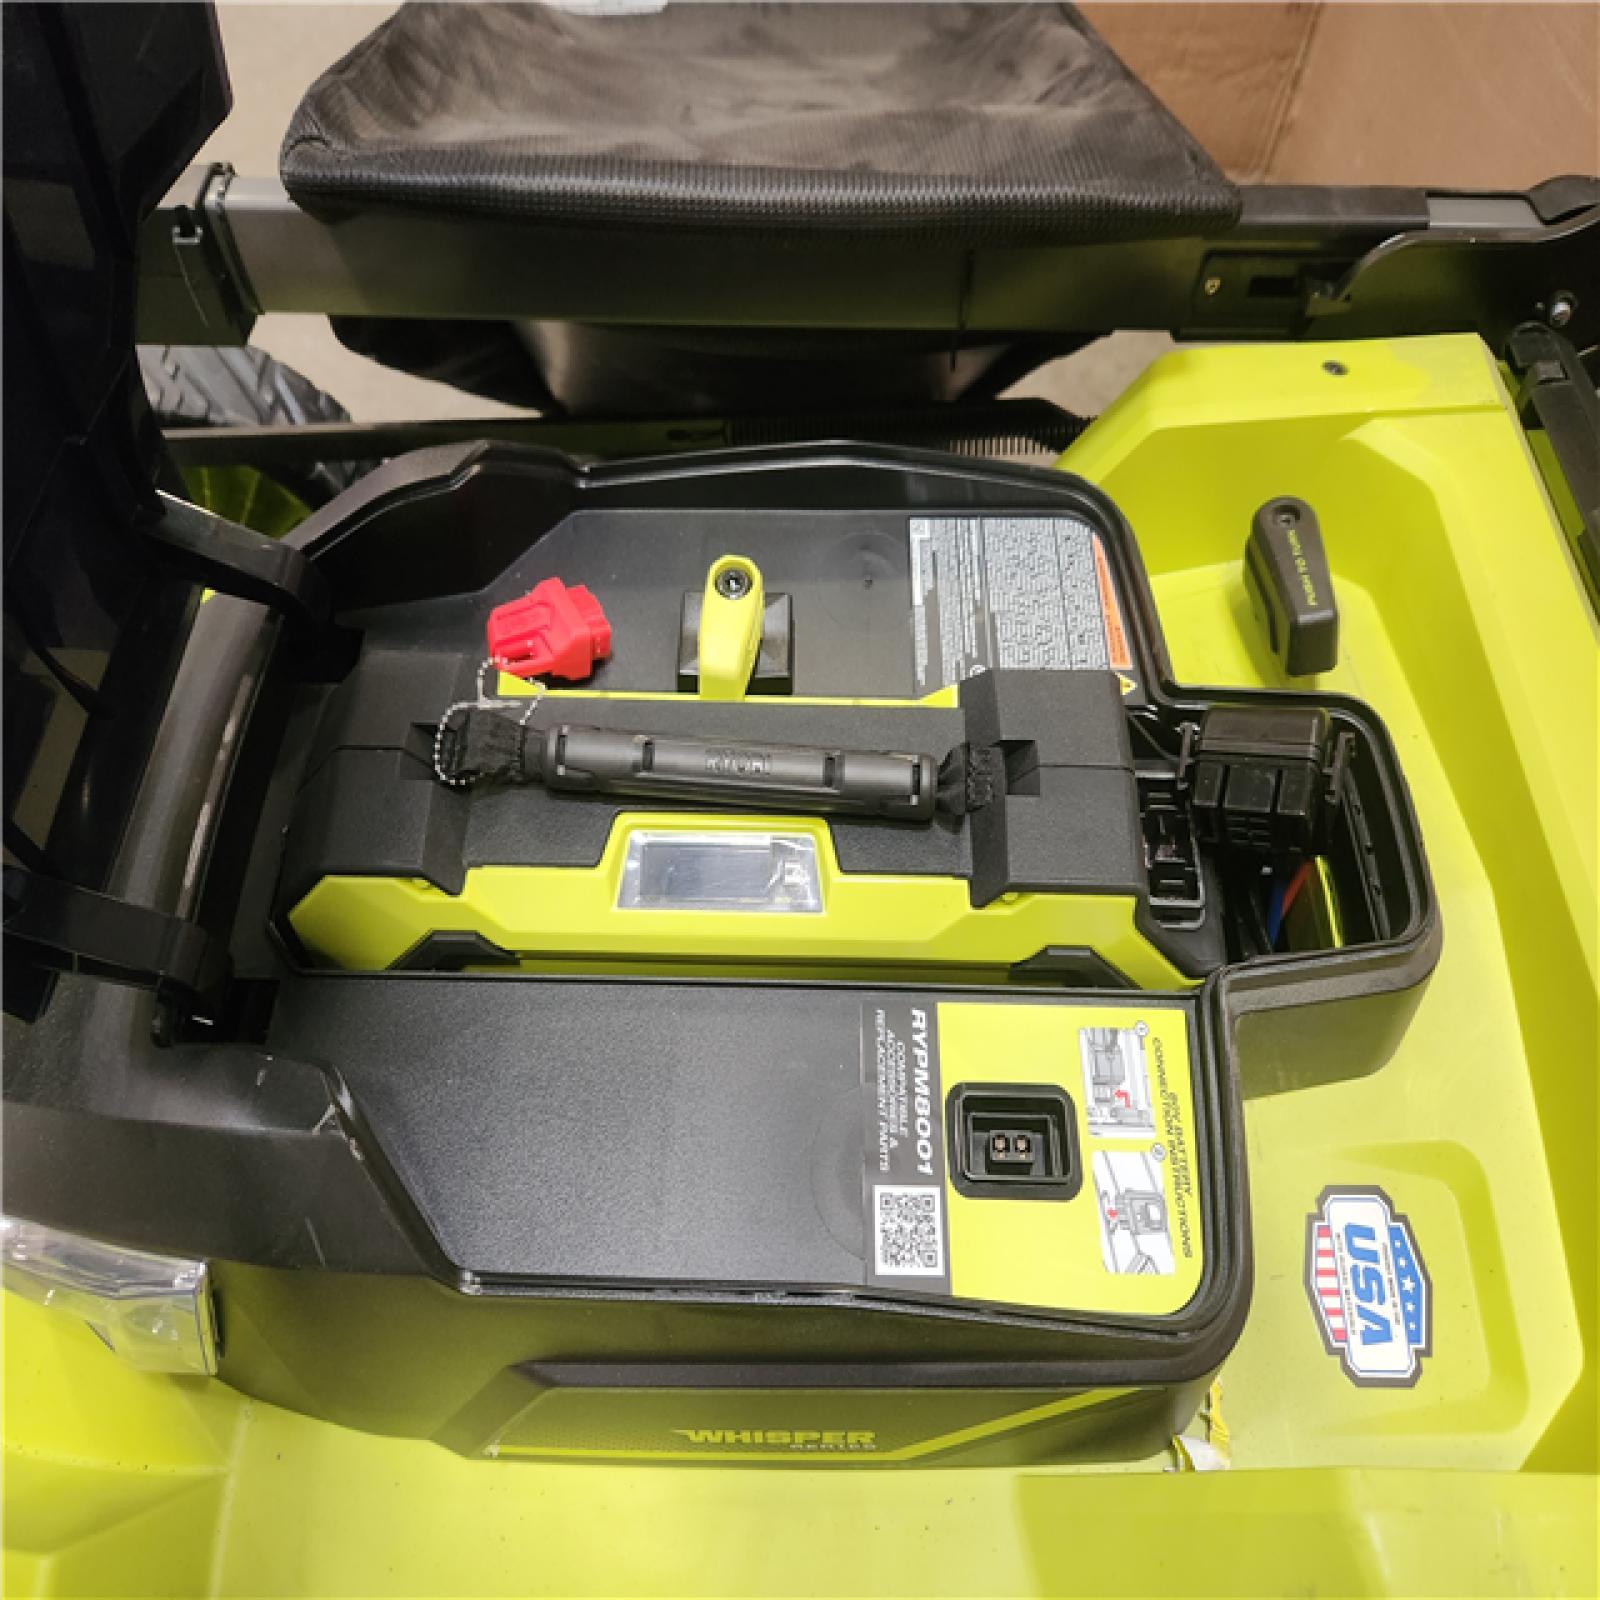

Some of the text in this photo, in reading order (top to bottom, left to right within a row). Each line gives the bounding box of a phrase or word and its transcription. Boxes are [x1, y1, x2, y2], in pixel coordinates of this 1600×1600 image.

[875, 1008, 890, 1172] REPLACEMENT PARTS
[886, 1029, 899, 1134] ACCESSORIES
[897, 1039, 909, 1138] COMPATIBLE
[911, 1008, 933, 1176] RYPM8001
[1151, 1036, 1174, 1136] CONNECTION
[1167, 1138, 1193, 1259] INSTRUCTIONS
[1173, 1126, 1192, 1198] BATTERY
[1343, 1223, 1393, 1346] USA
[680, 1429, 876, 1444] WHISPER
